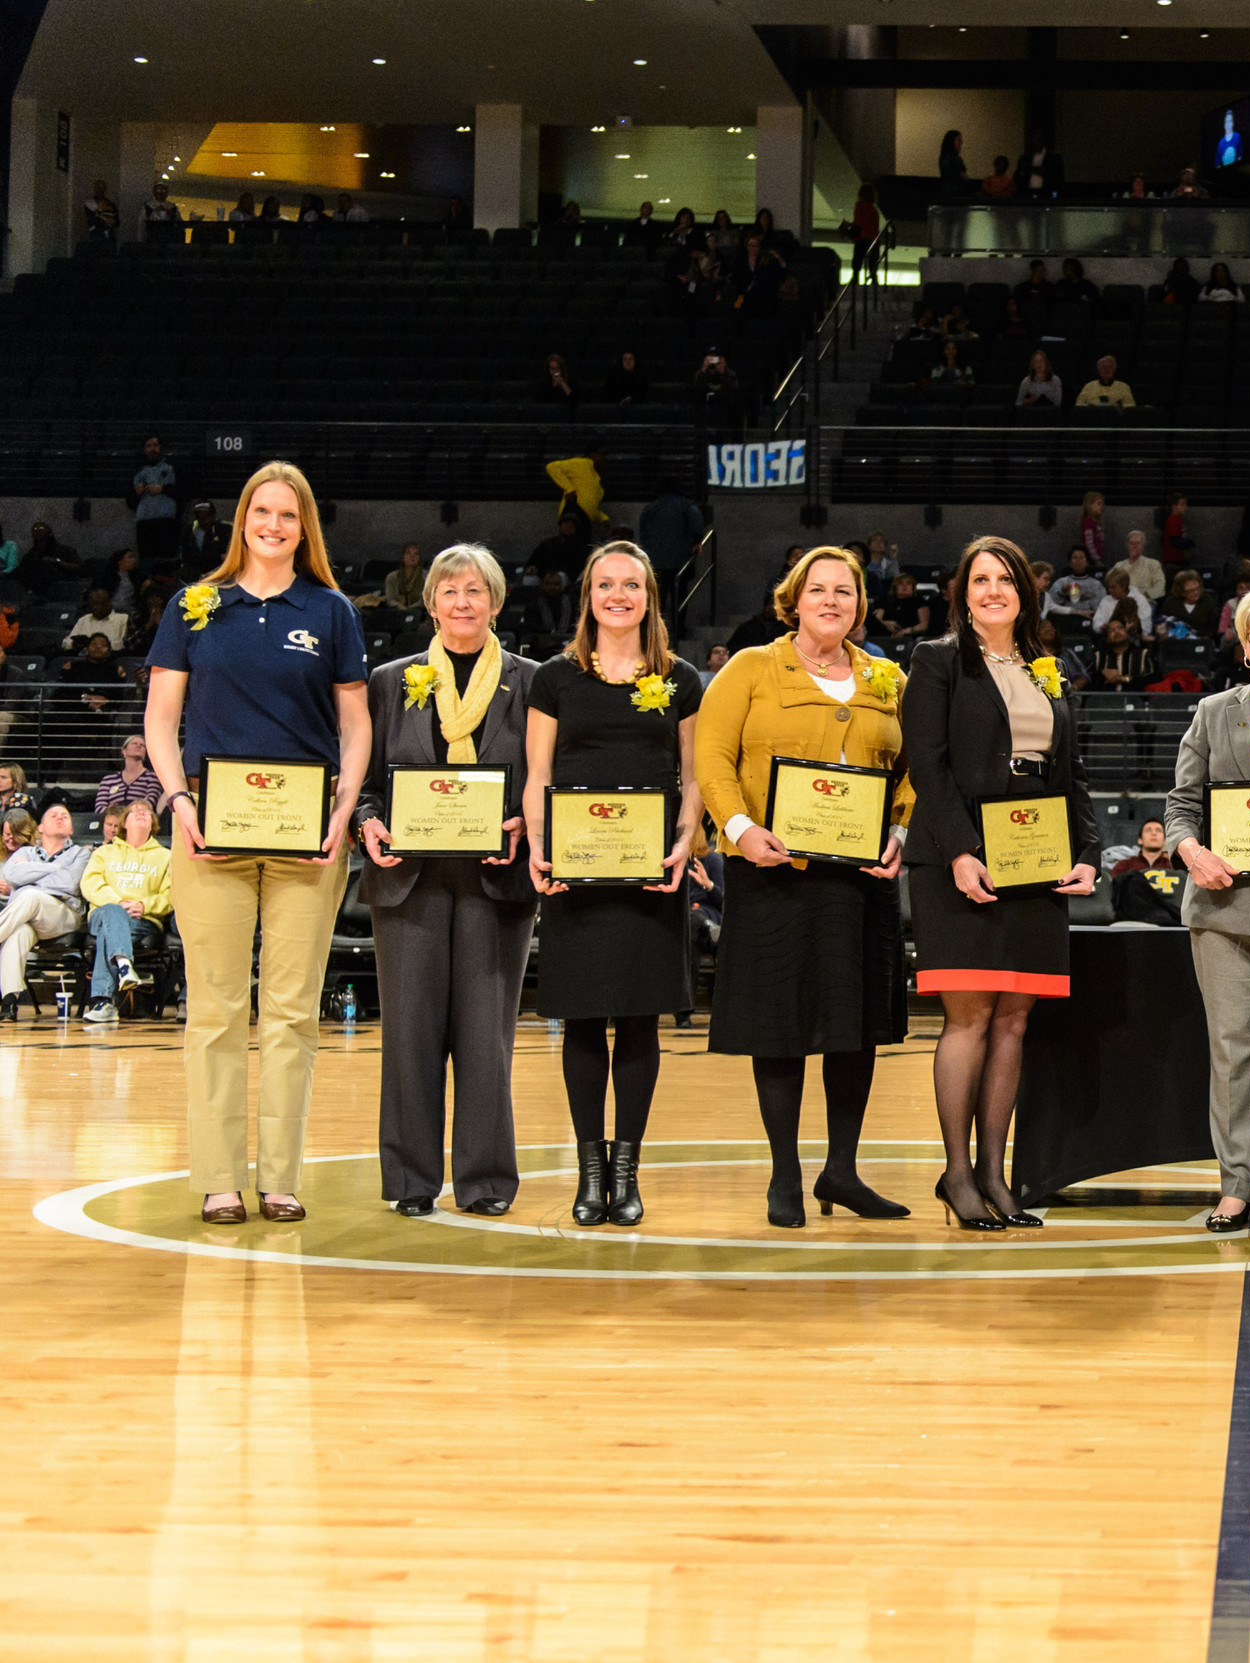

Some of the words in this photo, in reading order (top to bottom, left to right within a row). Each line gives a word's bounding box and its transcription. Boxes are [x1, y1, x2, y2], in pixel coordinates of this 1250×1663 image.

[215, 436, 242, 450] 108
[287, 630, 319, 649] GT
[792, 816, 820, 825] WOMEN
[822, 819, 837, 827] OUT
[108, 861, 158, 877] GEORGIA
[1144, 870, 1179, 894] GT
